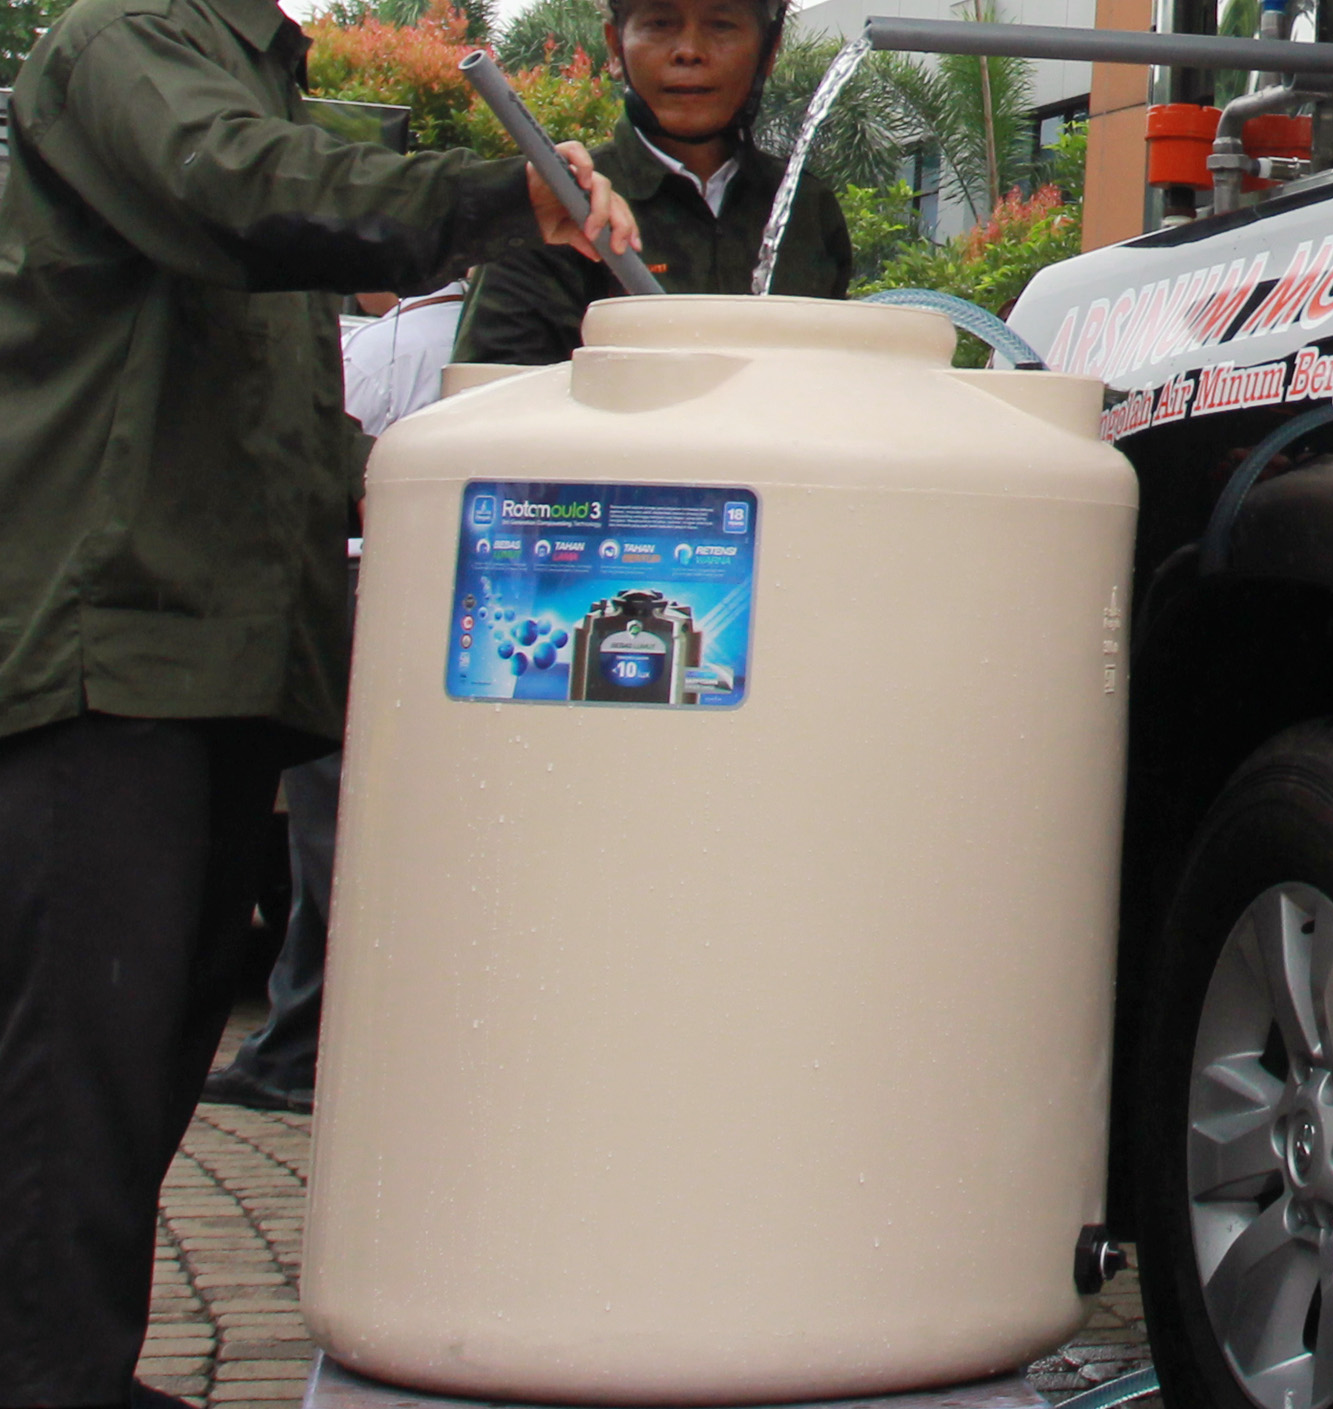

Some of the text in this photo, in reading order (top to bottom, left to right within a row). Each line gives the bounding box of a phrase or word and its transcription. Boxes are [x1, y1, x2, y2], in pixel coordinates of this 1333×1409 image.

[1047, 251, 1271, 385] ARSINUM
[1101, 381, 1155, 445] ngolah
[1151, 370, 1195, 426] Air
[1190, 360, 1288, 417] Minum
[502, 499, 589, 519] Rotamould
[590, 501, 602, 519] 3
[727, 508, 744, 521] 18
[554, 541, 585, 552] TAHAN
[623, 543, 655, 554] TAHAN
[695, 546, 737, 556] RETENSI
